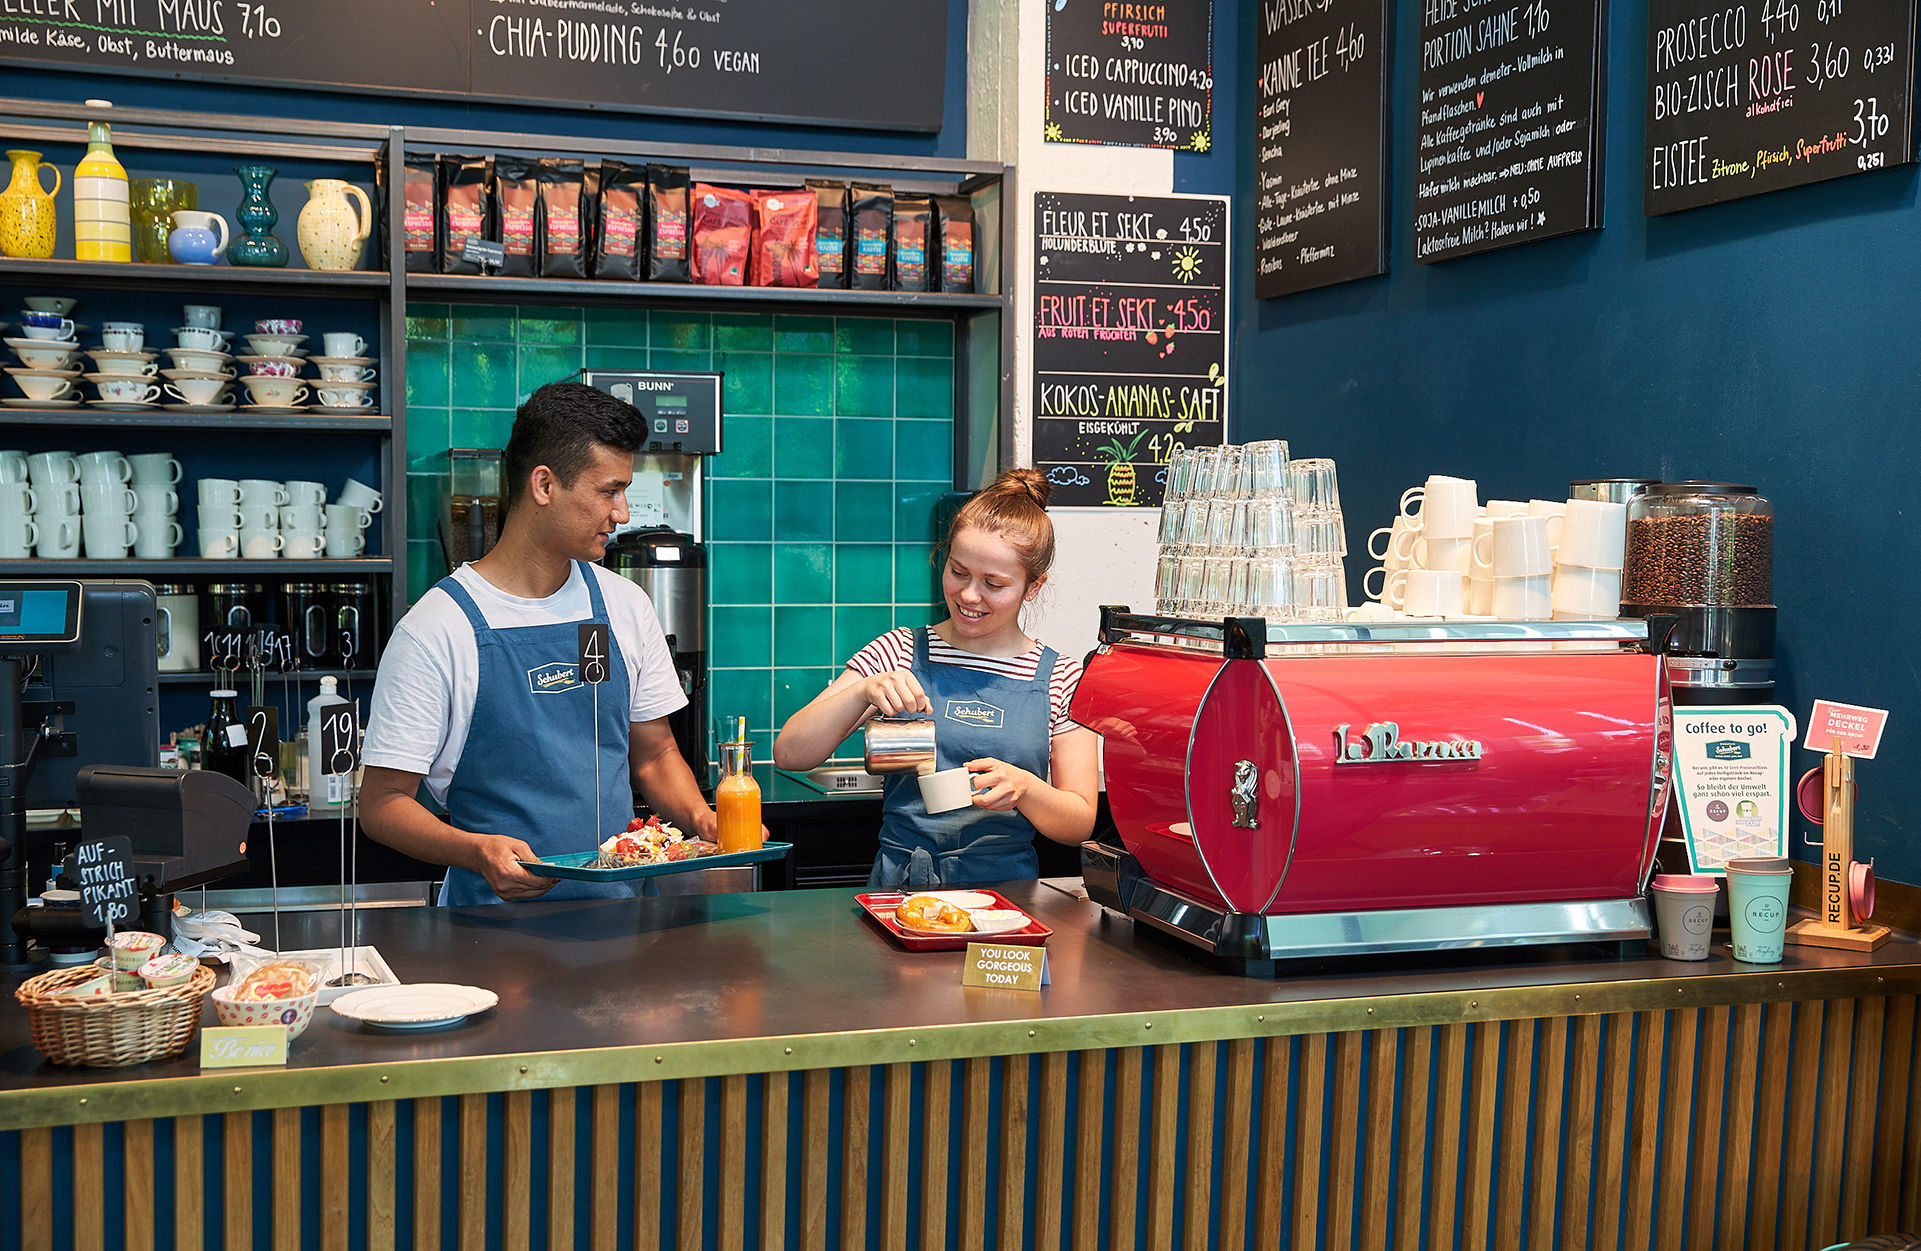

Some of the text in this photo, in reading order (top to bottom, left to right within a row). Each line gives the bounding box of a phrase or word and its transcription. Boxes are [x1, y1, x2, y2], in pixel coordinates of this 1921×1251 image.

[157, 0, 224, 35] MAUS
[236, 3, 282, 39] 7,10
[687, 7, 697, 20] &
[699, 10, 721, 23] Obst
[1104, 2, 1165, 21] PFIRSICH
[1102, 20, 1168, 38] SUPERFRUTTI
[1423, 0, 1550, 72] PORTION SAHNE 1,10
[1657, 0, 1799, 73] PROSECCO 4,40
[46, 28, 91, 53] Käse,
[98, 35, 139, 61] Obst,
[146, 40, 235, 65] Buttermaus
[489, 15, 760, 74] CHIA-PUDDING 4,60 VEGAN
[1263, 22, 1365, 98] KANNE TEE 4,60
[1065, 54, 1213, 90] ICED CAPPUCCINO 4,20
[1422, 45, 1564, 104] Wir verwenden demeter-Vollmilch in
[1655, 64, 1739, 121] BIO-ZISCH
[1749, 49, 1796, 101] ROSE
[1806, 41, 1850, 91] 3,60
[1065, 90, 1202, 128] ICED VANILLE PINO
[1262, 97, 1291, 118] Earl Grey
[1421, 100, 1476, 127] Pfandflaschen.
[1745, 95, 1794, 118] alkoholfrei
[1262, 119, 1291, 140] Darjeeling
[1420, 93, 1564, 151] Alle Kaffeegetränke sind auch mit
[1153, 127, 1177, 144] 3,90
[1420, 146, 1471, 175] Lupinenkaffee
[1514, 123, 1550, 148] Sojamilch
[1555, 119, 1577, 135] oder
[1652, 136, 1709, 190] EISTEE
[1756, 145, 1793, 170] Pfirsich,
[1795, 131, 1848, 163] Superfrutti
[1849, 97, 1890, 149] 3,70
[1262, 144, 1283, 163] Sencha
[1261, 171, 1282, 191] Yasmin
[1325, 173, 1339, 188] ohne
[1340, 168, 1358, 182] Minze
[1419, 176, 1460, 198] Hafermilch
[1547, 150, 1583, 171] AUFPREIS
[1328, 193, 1339, 211] mit
[1341, 192, 1360, 206] Minze
[1521, 187, 1540, 210] 0,50
[404, 219, 433, 228] ESPRESSO
[452, 220, 481, 228] ESPRESSO
[505, 223, 533, 232] ESPRESSO
[549, 223, 578, 231] ESPRESSO
[607, 224, 635, 233] ESPRESSO
[659, 228, 685, 236] ESPRESSO
[1042, 211, 1211, 243] FLEUR ET SEKT 4,50
[1417, 232, 1460, 258] Laktosefreie
[1462, 221, 1489, 245] Milch?
[1491, 221, 1515, 240] Haben
[1040, 295, 1210, 333] FRUIT ET SEKT 4,50
[1038, 327, 1056, 339] AUS
[222, 633, 241, 658] 11
[275, 635, 291, 661] 17
[342, 631, 352, 658] 3
[584, 630, 605, 674] 4
[537, 668, 574, 686] Schubert
[954, 706, 995, 717] Schubert
[1829, 711, 1868, 723] MEHRWEG
[252, 711, 273, 761] 2
[323, 711, 353, 756] 19
[1685, 722, 1768, 736] Coffee to go!
[1828, 719, 1865, 731] DECKEL
[1715, 745, 1741, 754] Schubert
[80, 861, 124, 885] STRICH
[83, 878, 135, 904] PIKANT
[1828, 852, 1840, 923] RECUP.DE
[980, 948, 1030, 961] YOU LOOK
[977, 960, 1032, 973] GORGEOUS
[985, 973, 1019, 985] TODAY
[210, 1036, 276, 1059] Be nice
